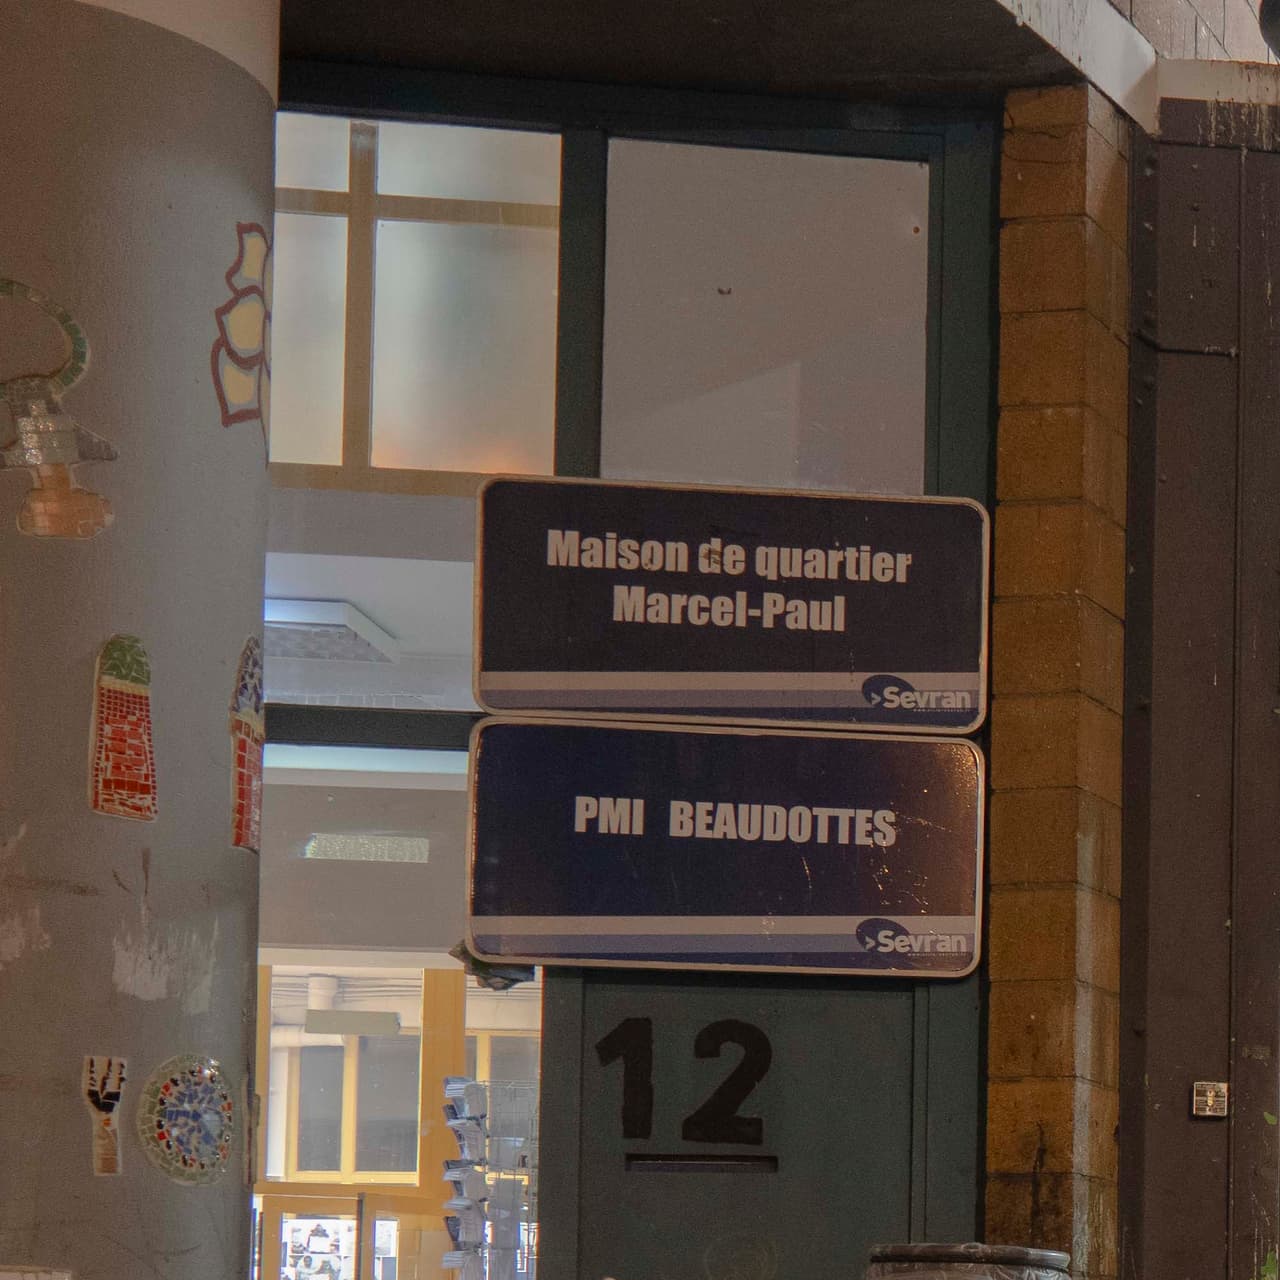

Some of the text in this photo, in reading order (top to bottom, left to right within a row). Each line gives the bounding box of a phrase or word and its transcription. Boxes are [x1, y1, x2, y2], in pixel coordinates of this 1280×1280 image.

[547, 529, 913, 584] Maison de quartier
[612, 584, 847, 632] Marcel-Paul
[882, 686, 971, 709] Sevran
[574, 795, 897, 847] PMI BEAUDOTTES
[877, 930, 967, 953] Sevran
[595, 1017, 773, 1146] 12
